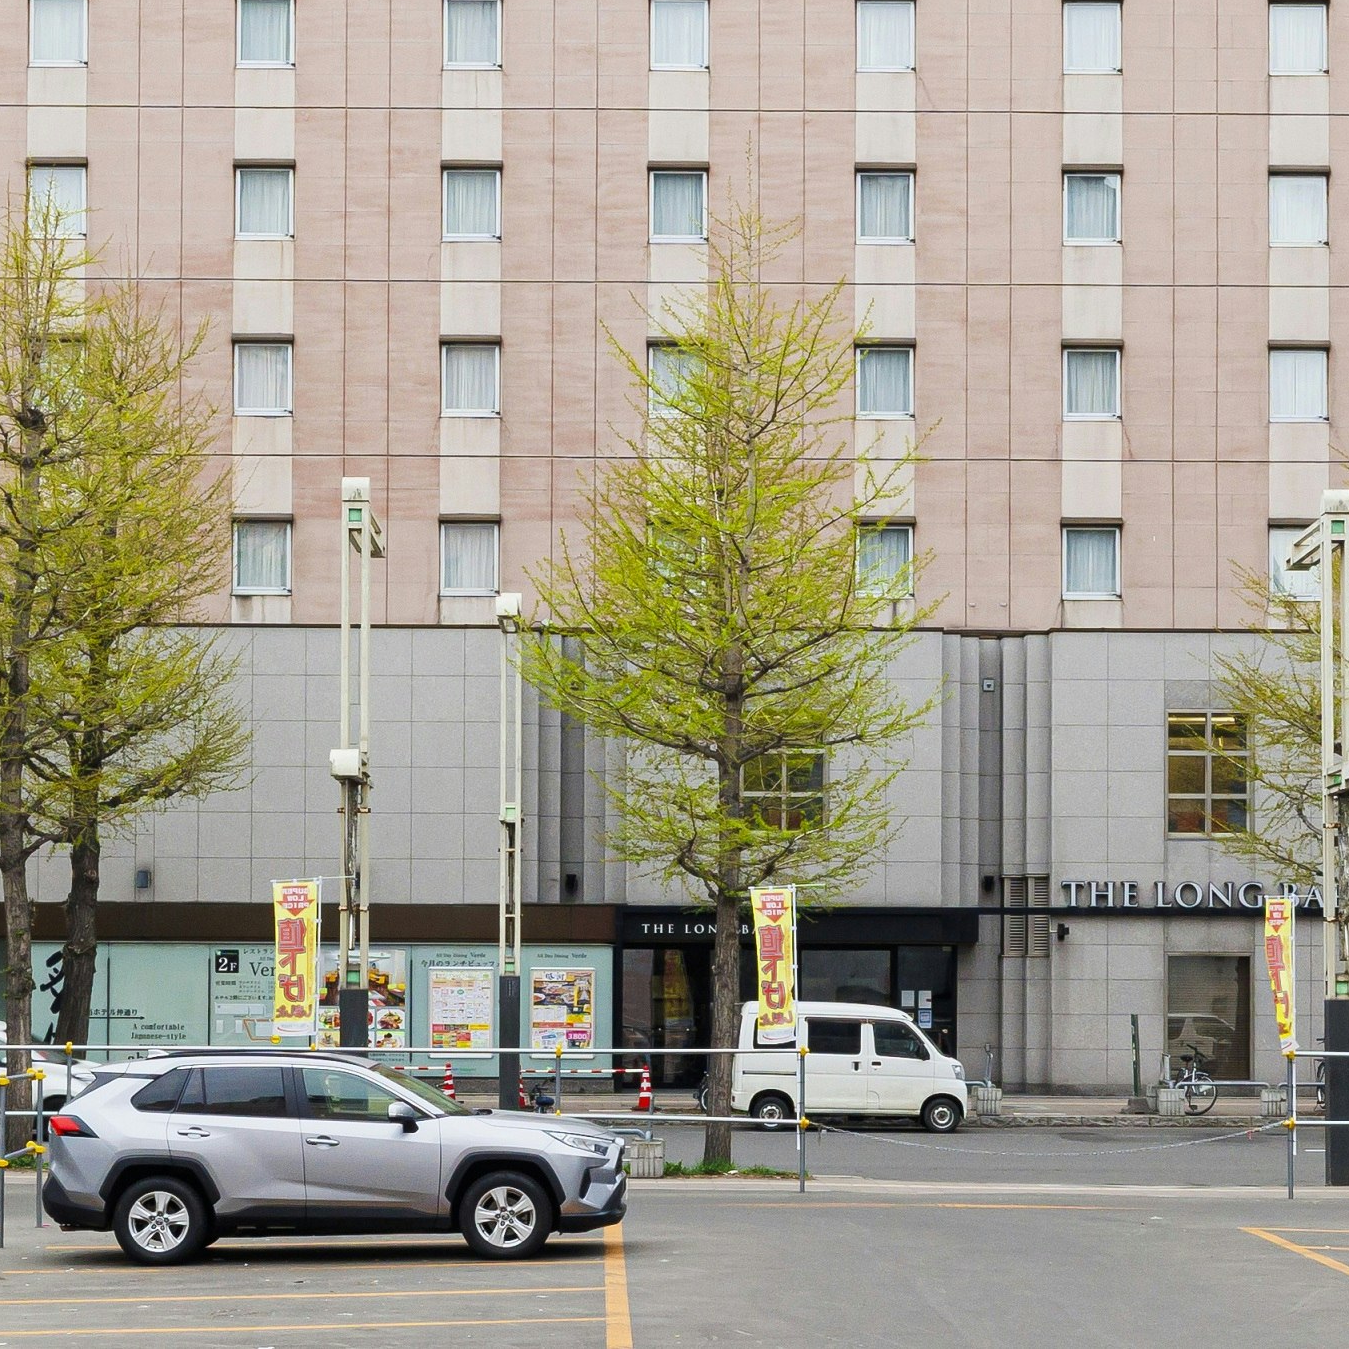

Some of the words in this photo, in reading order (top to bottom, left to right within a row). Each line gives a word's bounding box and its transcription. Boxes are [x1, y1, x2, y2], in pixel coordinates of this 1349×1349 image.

[1061, 880, 1139, 908] THE
[1154, 880, 1264, 909] LONG
[642, 923, 675, 934] THE
[218, 957, 238, 971] 2F
[421, 959, 500, 968] 今月のランチビュッフ
[249, 962, 276, 977] Ver
[141, 1022, 185, 1031] comfortable
[131, 1032, 186, 1041] Japanese-style
